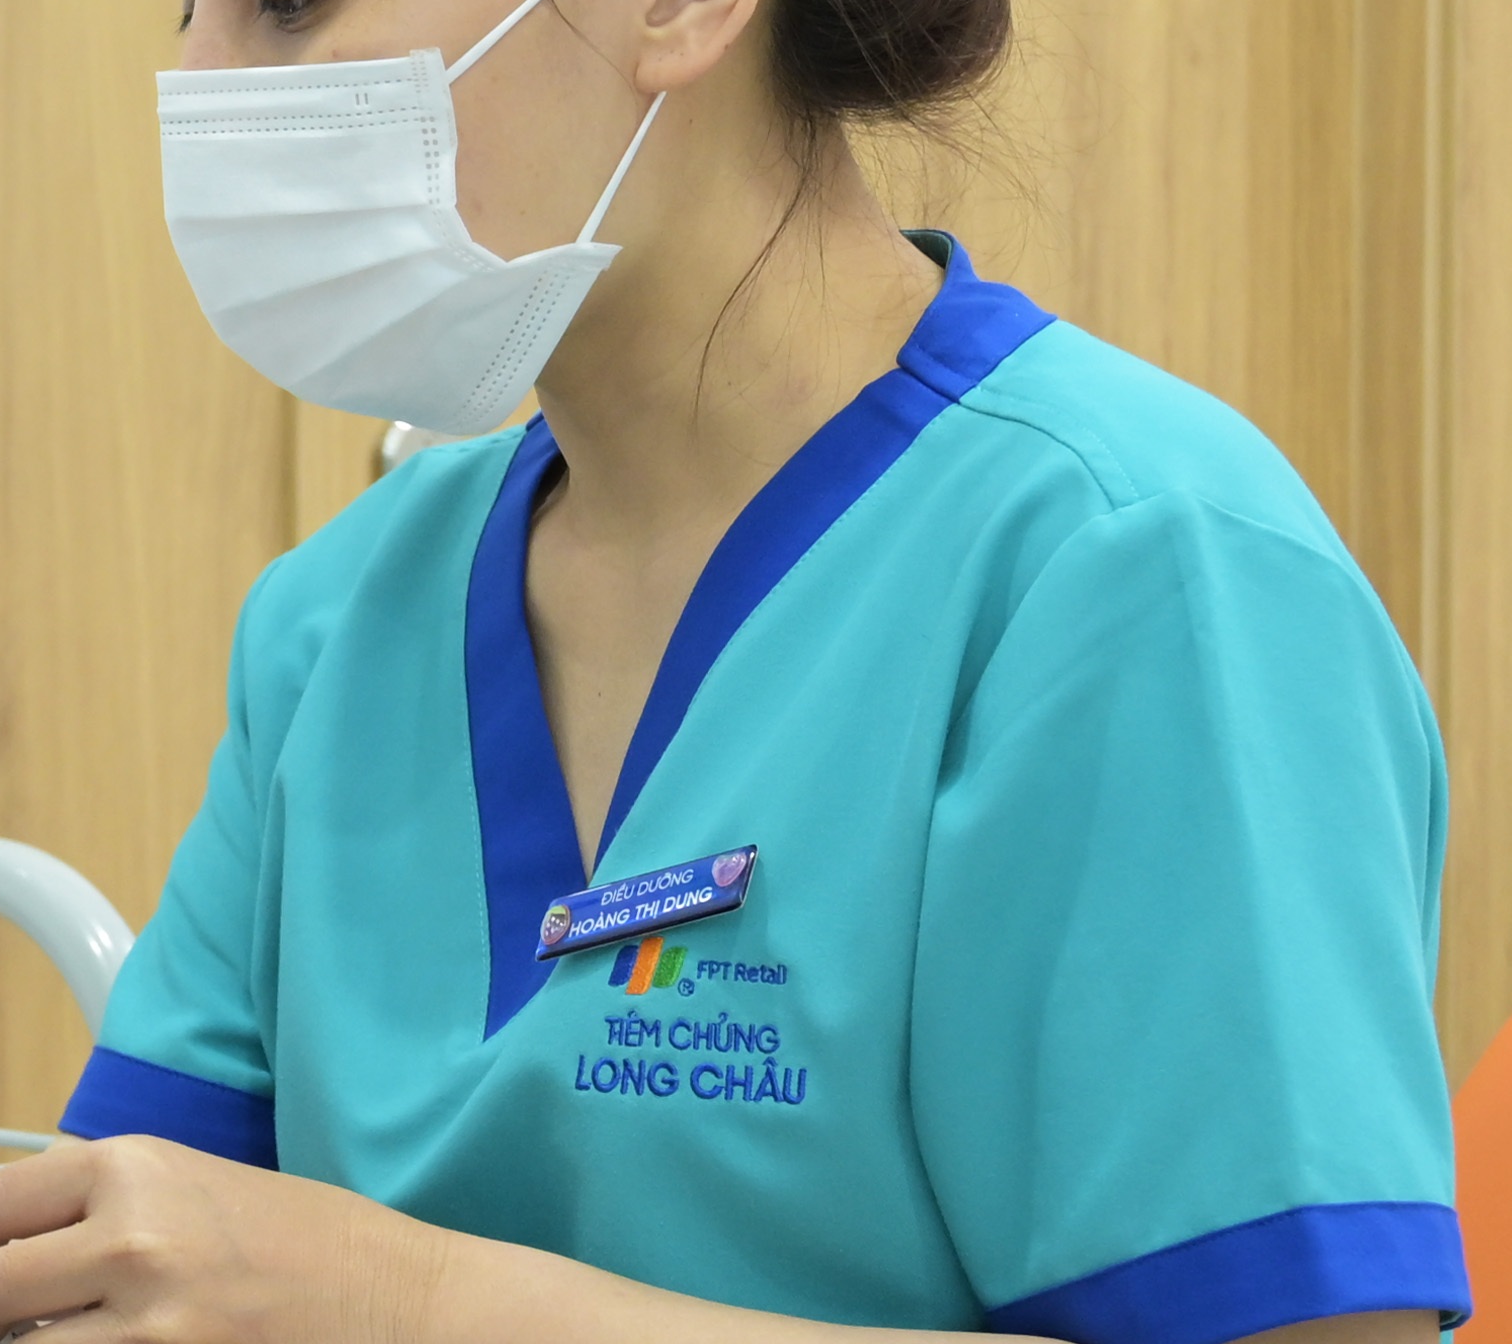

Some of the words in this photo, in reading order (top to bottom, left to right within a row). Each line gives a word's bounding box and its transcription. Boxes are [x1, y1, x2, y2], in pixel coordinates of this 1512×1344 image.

[601, 882, 635, 906] ĐIỀU
[637, 869, 694, 896] DƯỠNG
[569, 909, 630, 938] HOÀNG
[635, 900, 660, 919] THỊ
[663, 886, 713, 913] DUNG
[697, 960, 731, 981] FPT
[734, 961, 787, 986] Retail
[605, 1010, 661, 1047] TIÊM
[668, 1012, 781, 1054] CHỦNG
[575, 1055, 679, 1097] LONG
[690, 1057, 807, 1105] CHÂU
